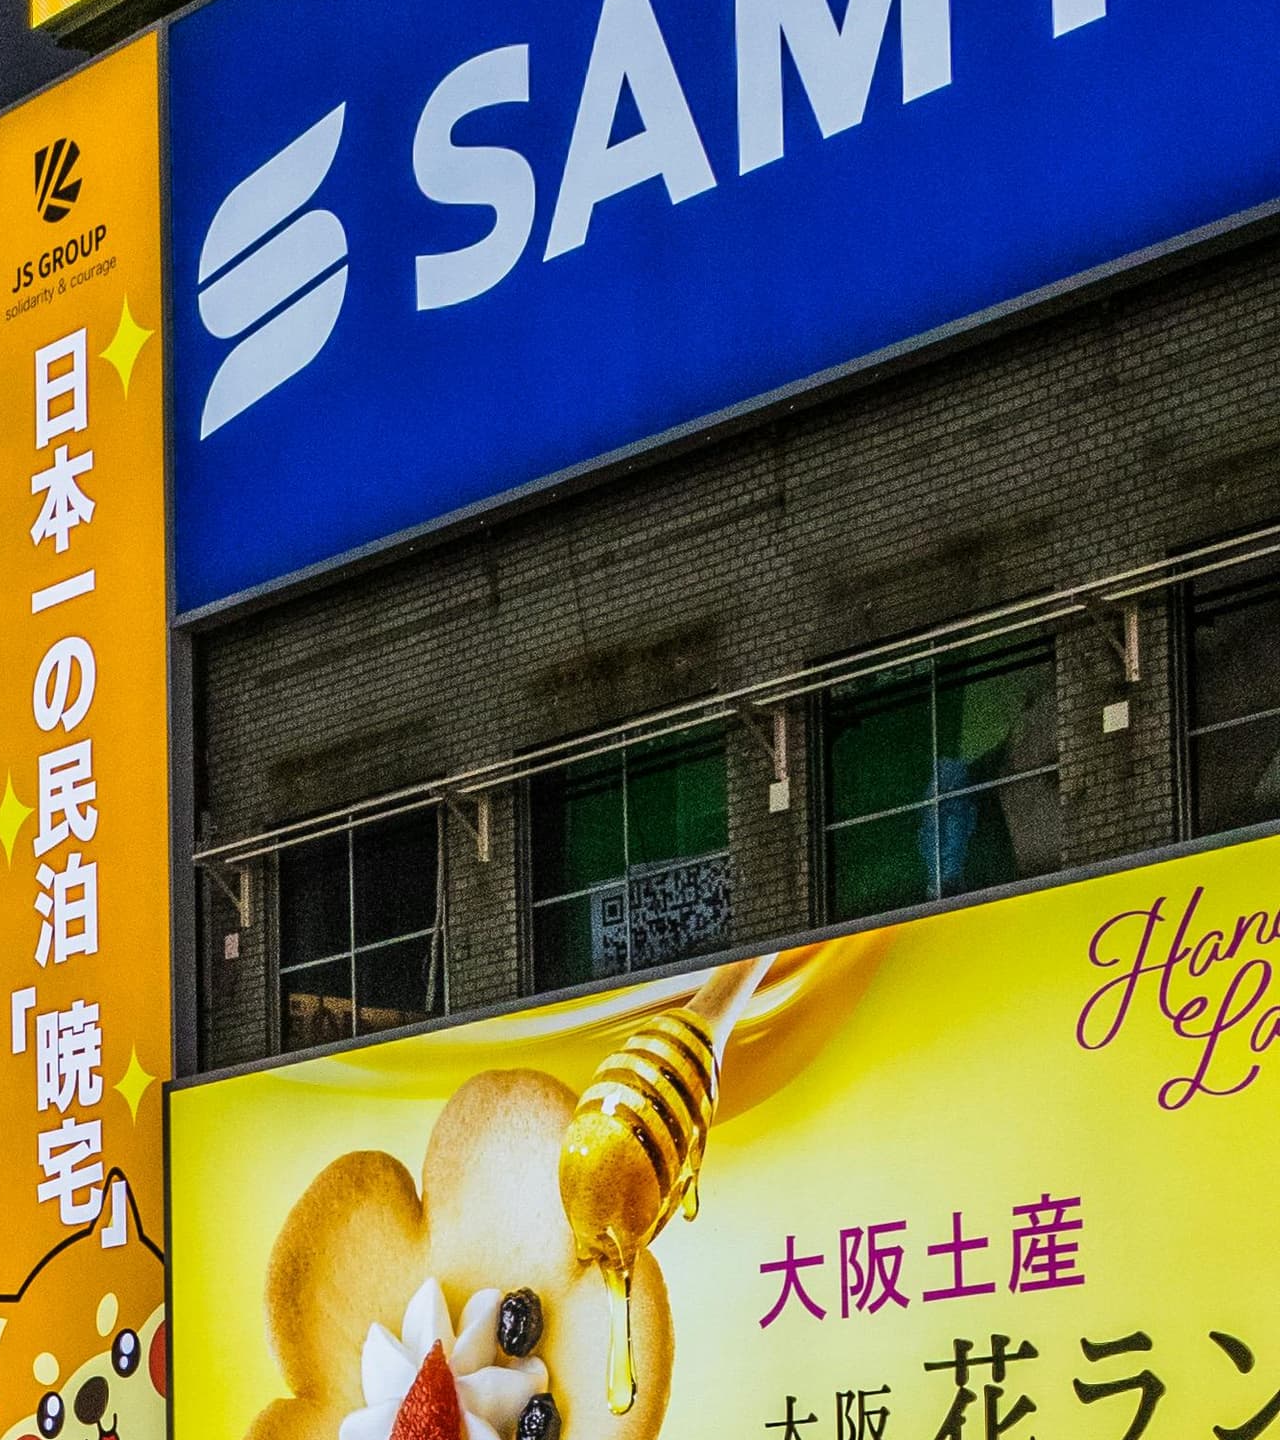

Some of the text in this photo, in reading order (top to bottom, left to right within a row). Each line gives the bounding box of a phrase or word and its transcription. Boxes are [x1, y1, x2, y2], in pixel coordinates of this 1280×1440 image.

[5, 254, 118, 322] solidarity & courage
[11, 224, 108, 295] JS GROUP
[758, 1191, 1087, 1330] 大阪土産
